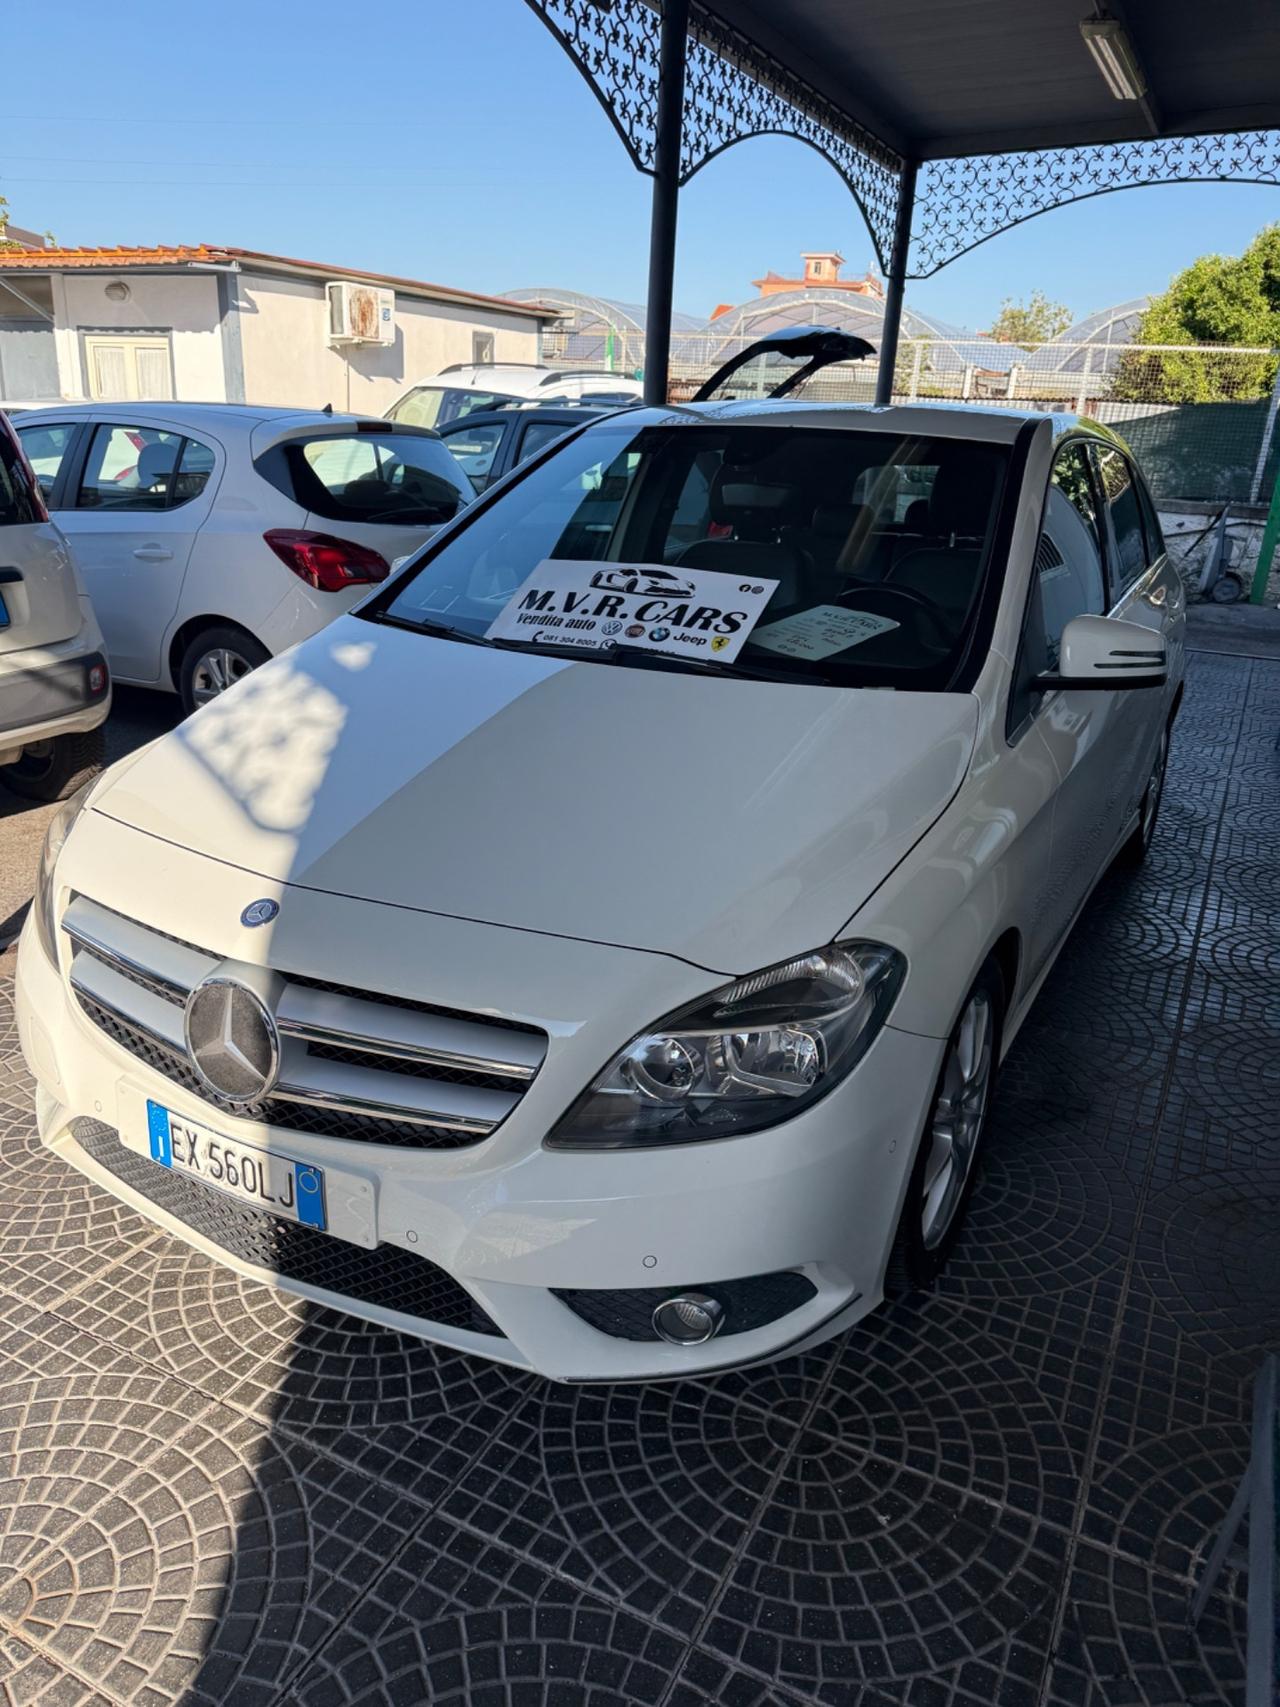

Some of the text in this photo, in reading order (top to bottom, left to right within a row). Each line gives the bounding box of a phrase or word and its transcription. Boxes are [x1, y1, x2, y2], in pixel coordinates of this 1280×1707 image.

[517, 613, 596, 631] Vendita auto
[673, 632, 707, 646] Jeep
